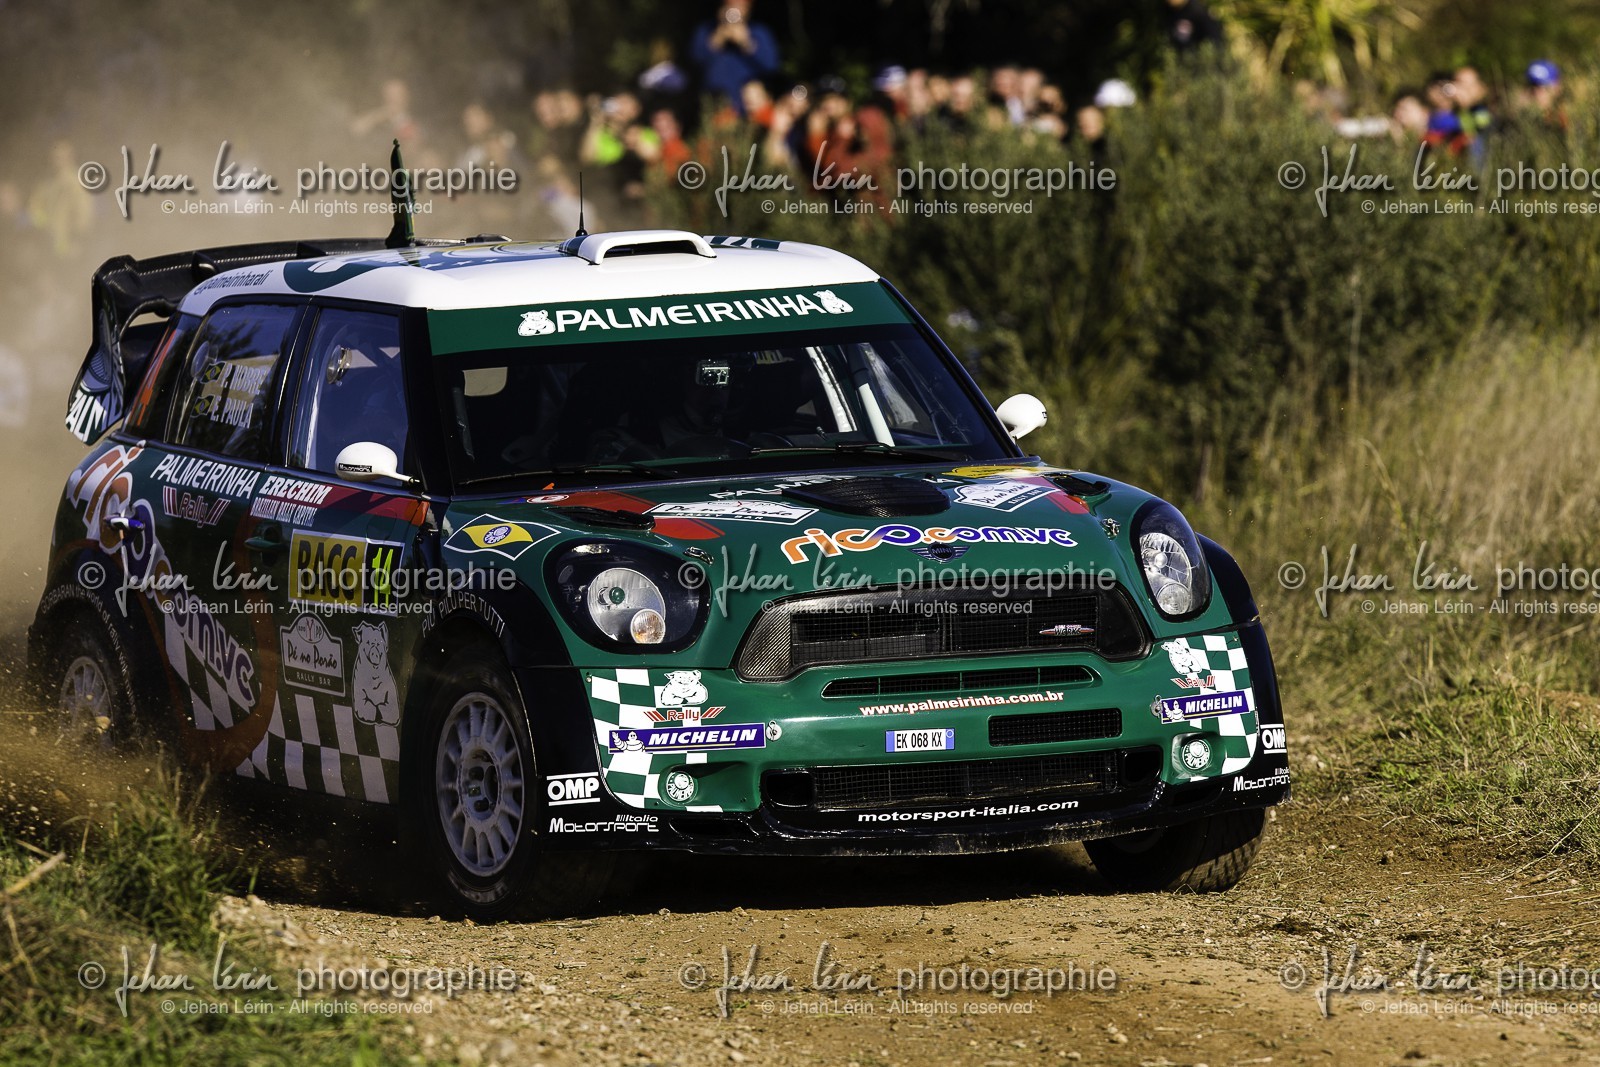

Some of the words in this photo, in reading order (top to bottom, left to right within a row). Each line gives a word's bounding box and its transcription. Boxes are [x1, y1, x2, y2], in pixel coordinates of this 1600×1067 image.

[556, 294, 826, 332] PALMEIRINHA
[220, 398, 254, 429] PAULA
[150, 453, 260, 499] PALMEIRINHA
[259, 476, 332, 504] ERECHIM
[179, 492, 208, 528] Rally
[780, 524, 1078, 564] rico.com.vc
[297, 539, 358, 600] RACC
[371, 547, 394, 608] 14
[457, 591, 477, 612] PER
[478, 597, 506, 638] TUTTI
[300, 652, 310, 664] no
[313, 644, 338, 669] Porão
[296, 671, 315, 682] RALLY
[319, 676, 331, 686] BAR
[667, 709, 700, 721] Rally
[859, 690, 1064, 716] www.palmeirinha.com.br
[1185, 695, 1243, 713] MICHELIN
[648, 728, 757, 746] MICHELIN
[897, 734, 908, 749] EK
[911, 733, 929, 748] 068
[931, 732, 943, 747] KX
[548, 777, 600, 800] OMP
[858, 800, 1079, 821] motorsport-italia.com
[549, 817, 659, 832] Motorsport
